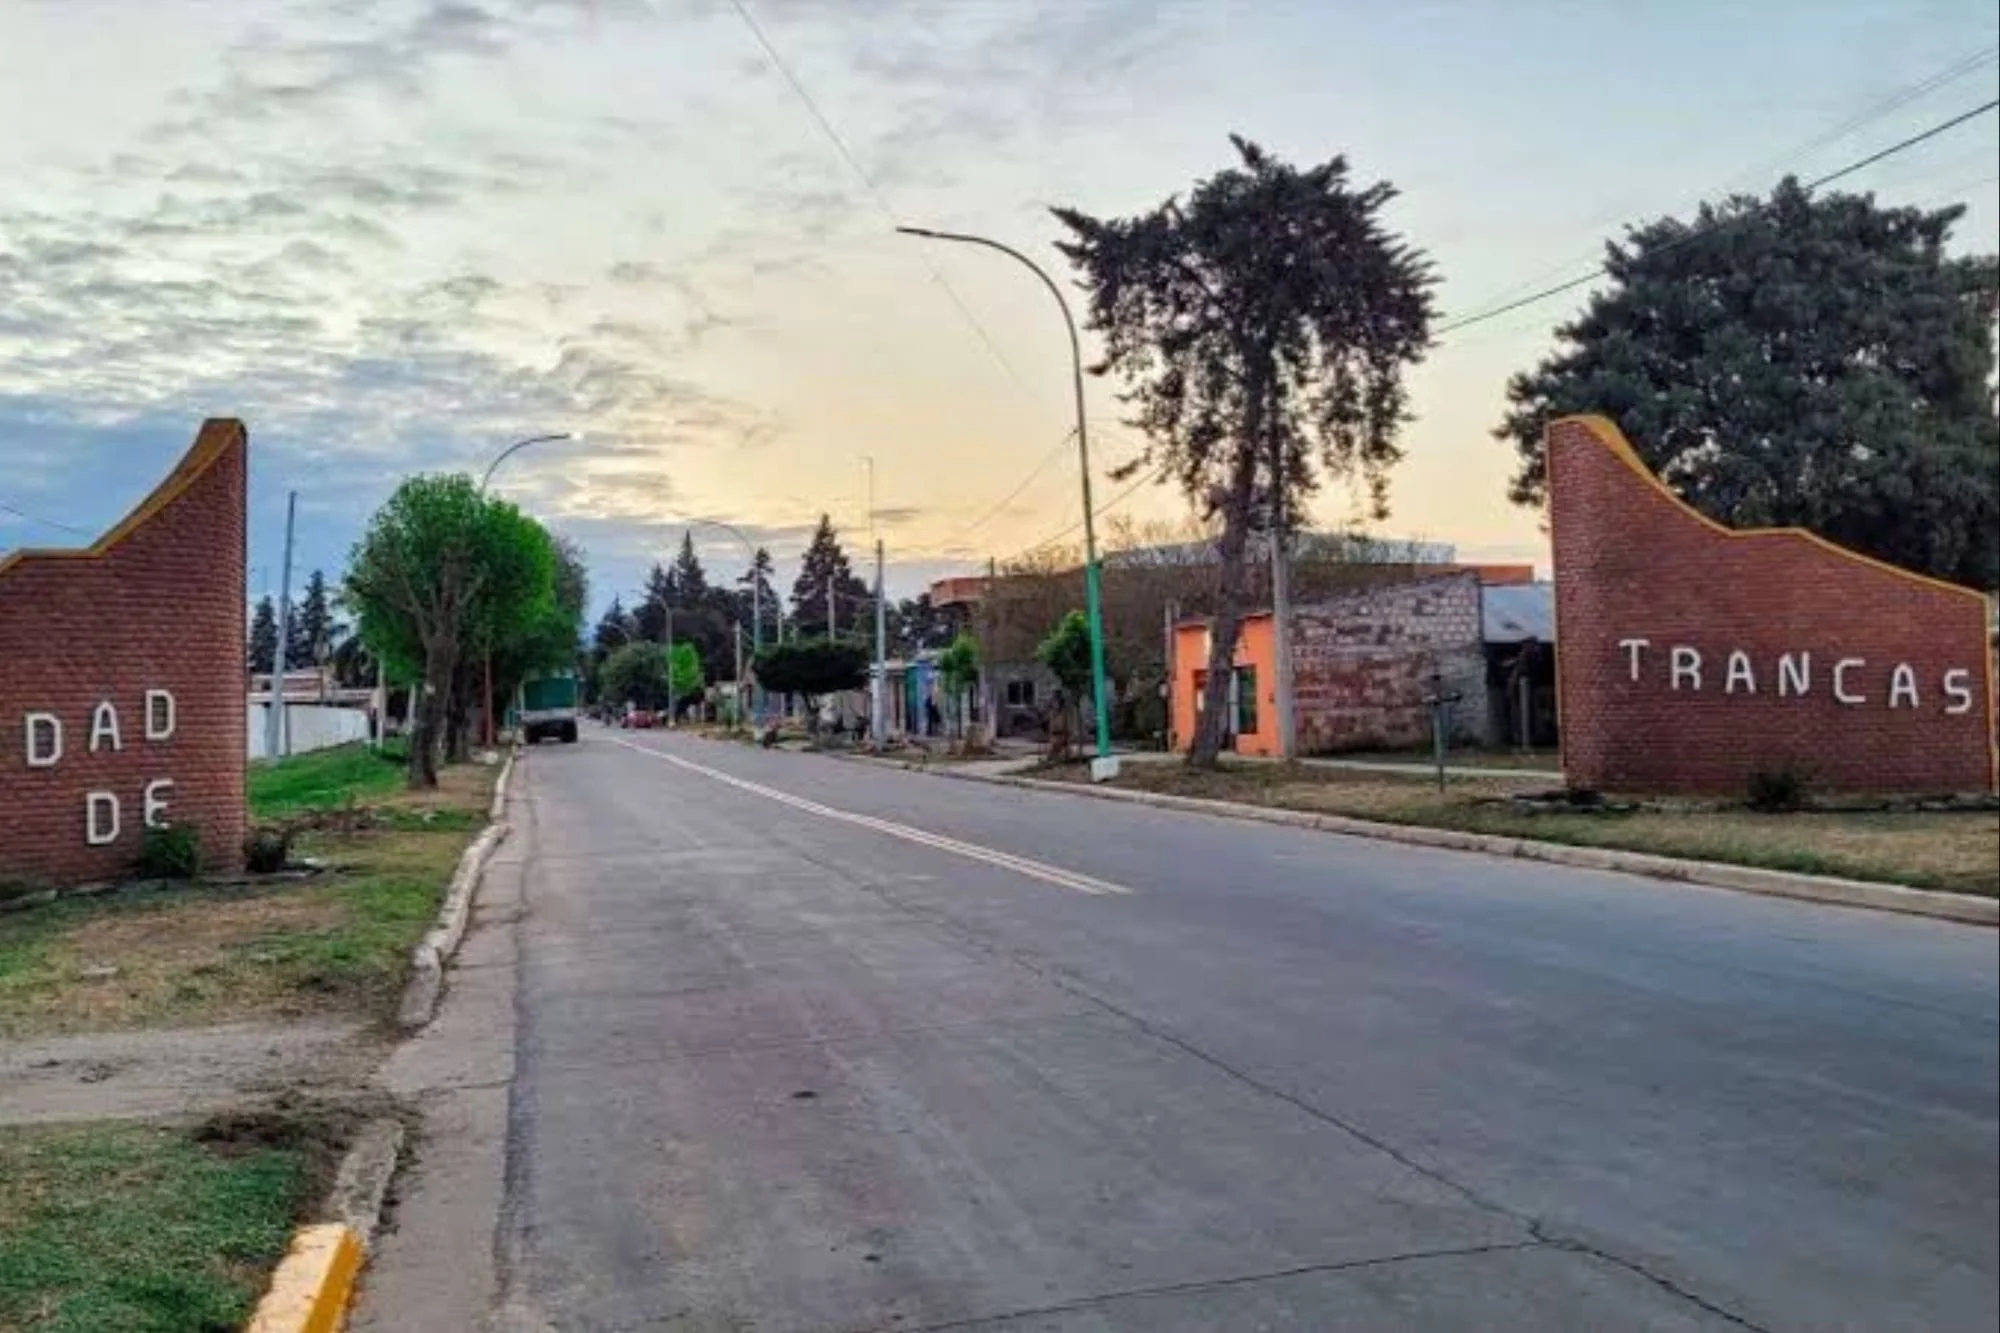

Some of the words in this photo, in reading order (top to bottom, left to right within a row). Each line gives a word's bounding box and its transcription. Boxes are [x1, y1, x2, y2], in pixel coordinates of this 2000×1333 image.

[1618, 638, 1972, 714] TRANCAS
[26, 688, 175, 766] DAD
[87, 779, 174, 844] DE
